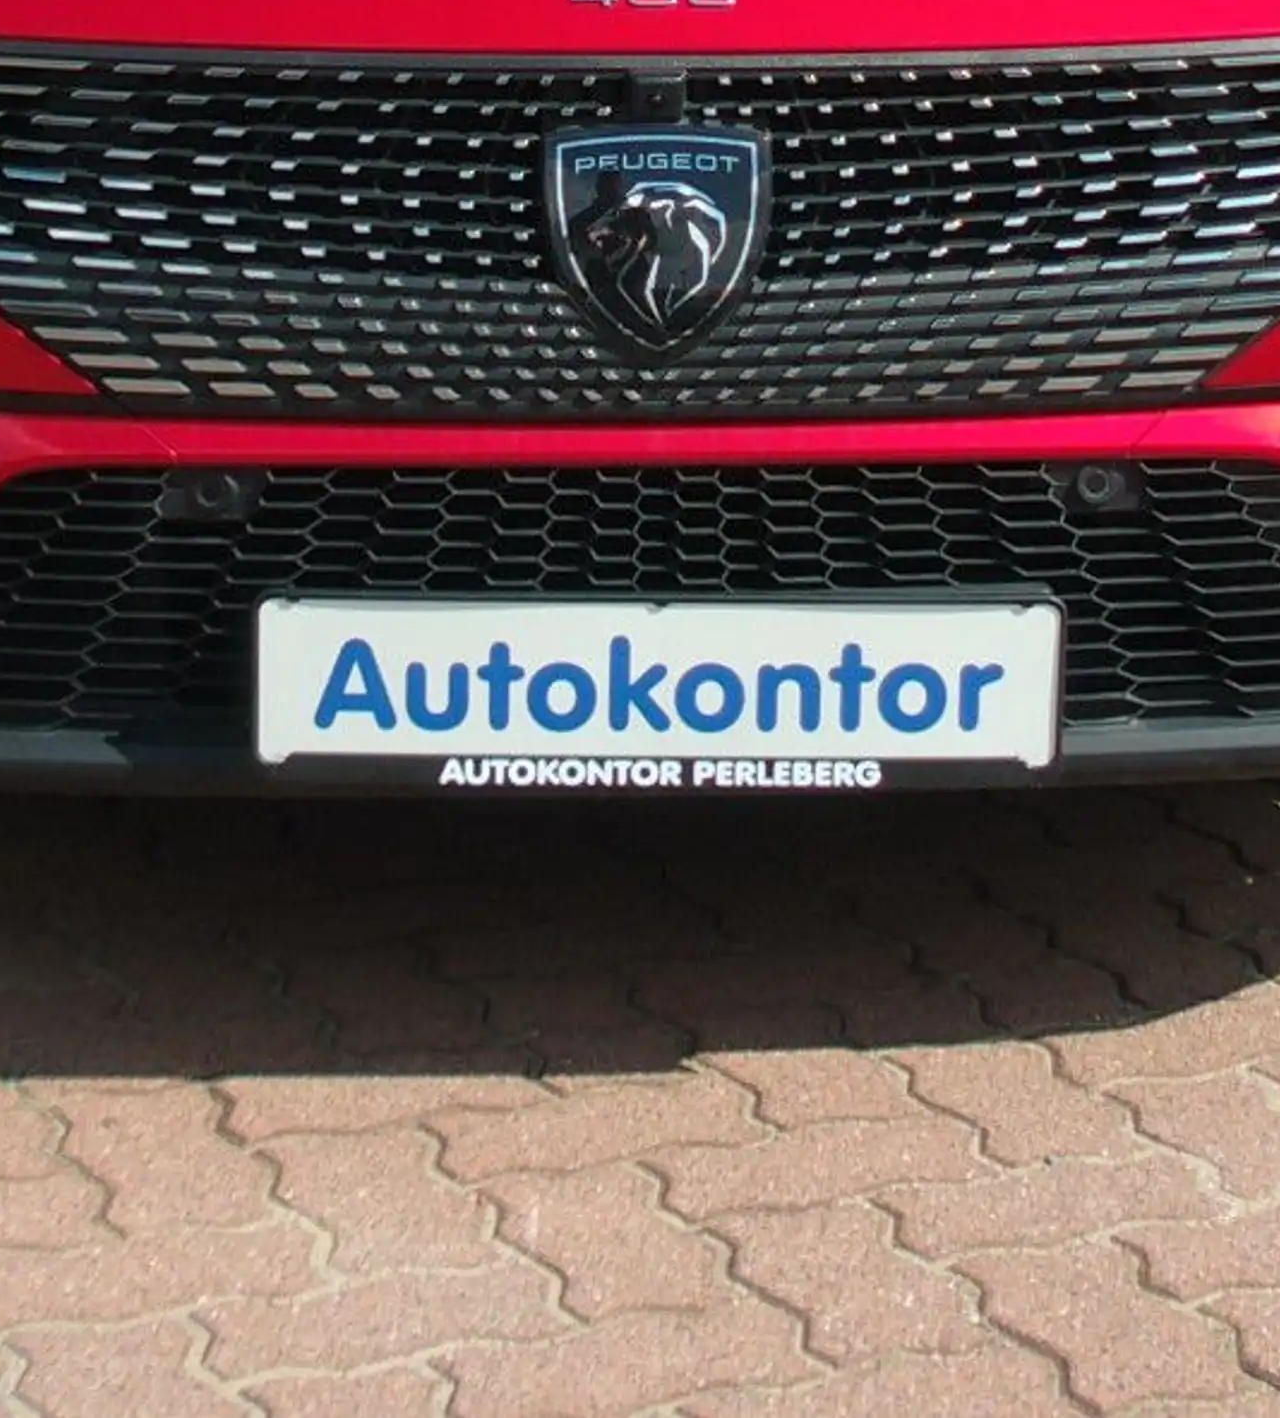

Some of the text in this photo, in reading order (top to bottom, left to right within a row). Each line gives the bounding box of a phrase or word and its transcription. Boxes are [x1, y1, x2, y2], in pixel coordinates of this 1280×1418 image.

[575, 153, 740, 174] PEUGEOT
[314, 635, 1005, 733] Autokontor
[439, 758, 882, 788] AUTOKONTOR PERLEBERG
